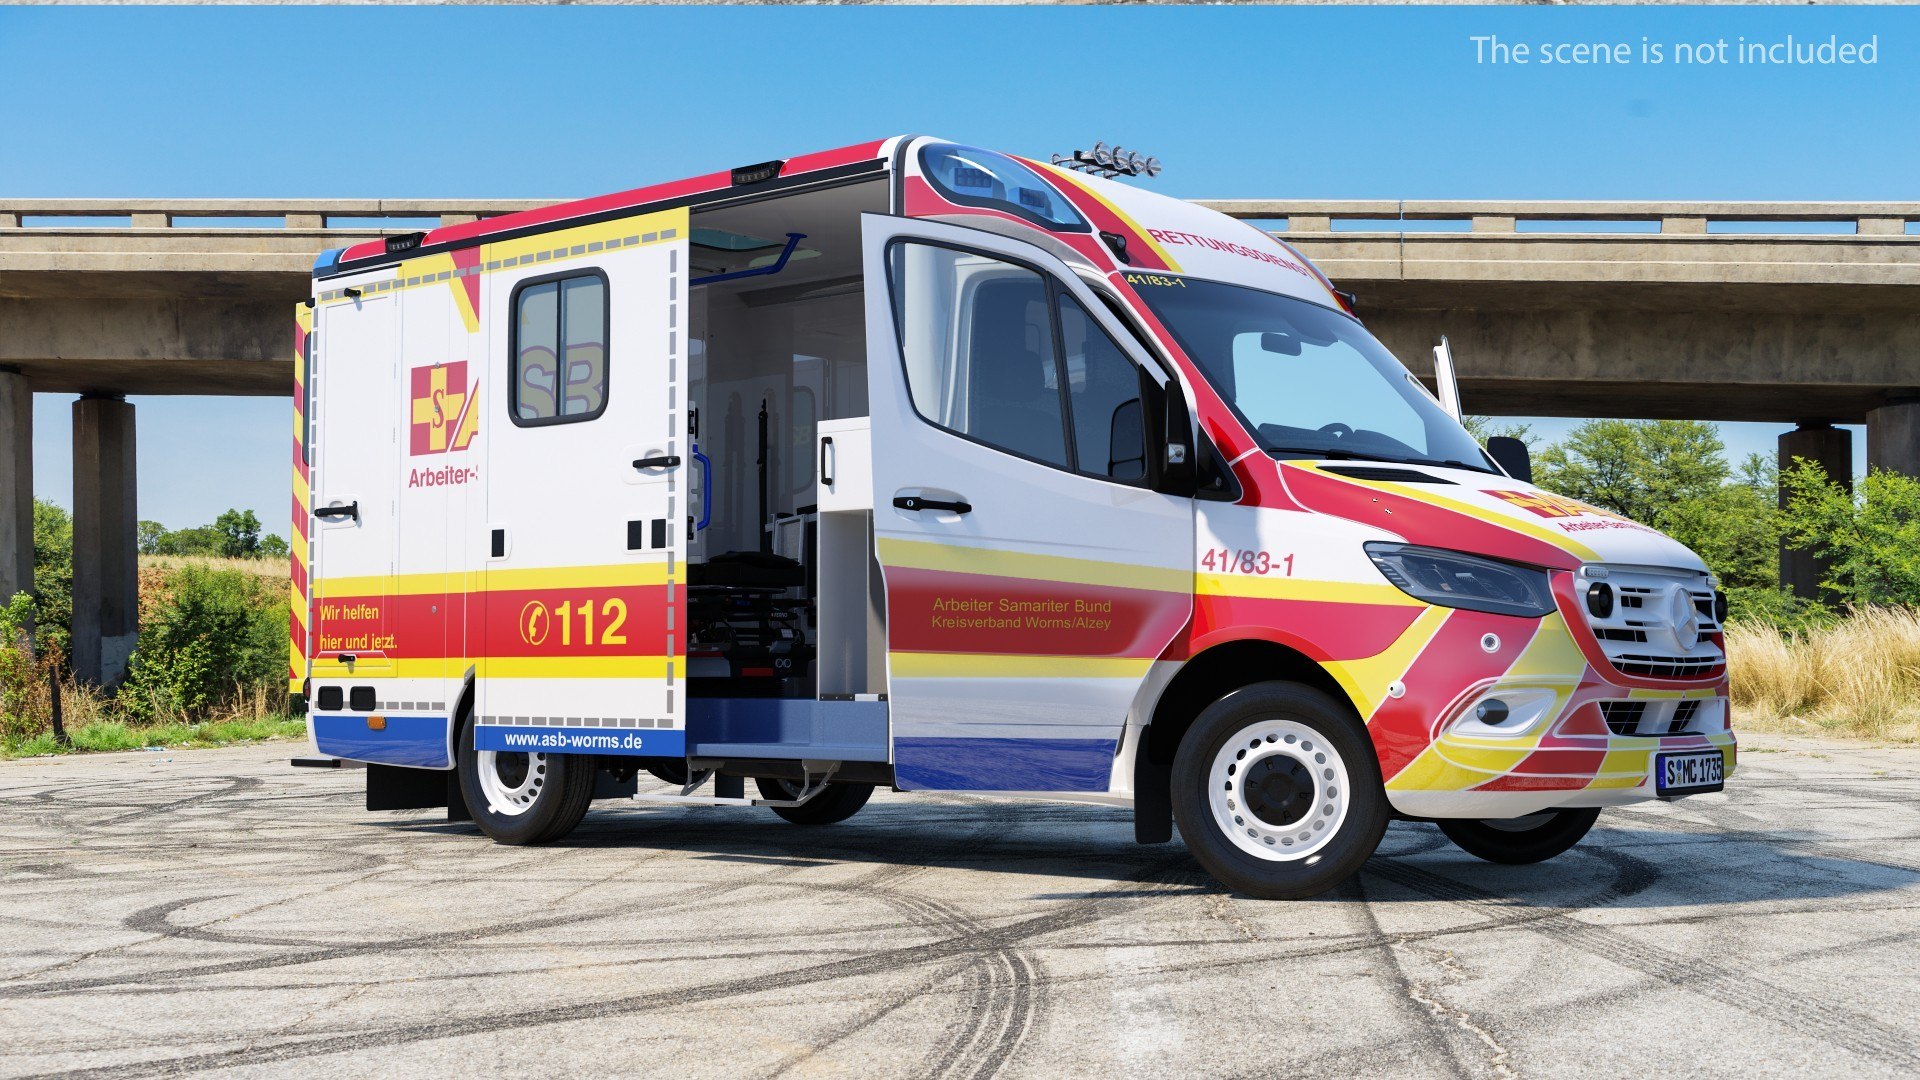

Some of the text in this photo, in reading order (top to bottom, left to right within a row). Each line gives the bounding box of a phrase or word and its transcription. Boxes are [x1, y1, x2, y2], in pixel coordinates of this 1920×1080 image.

[1146, 228, 1315, 281] RETTUNGSDIENST
[1127, 274, 1187, 288] 41/83-1
[408, 465, 479, 488] Arbeiter-
[1201, 548, 1294, 577] 41/83-1
[319, 603, 379, 621] Wir helfen
[932, 597, 1112, 613] Arbeiter Samariter Bund
[554, 597, 628, 646] 112
[932, 616, 1112, 631] Kreisverband Worms/Alzey
[320, 633, 398, 652] hier und jetzt.
[504, 731, 643, 749] www.asb-worms.de
[1667, 757, 1722, 785] S MC 1735
